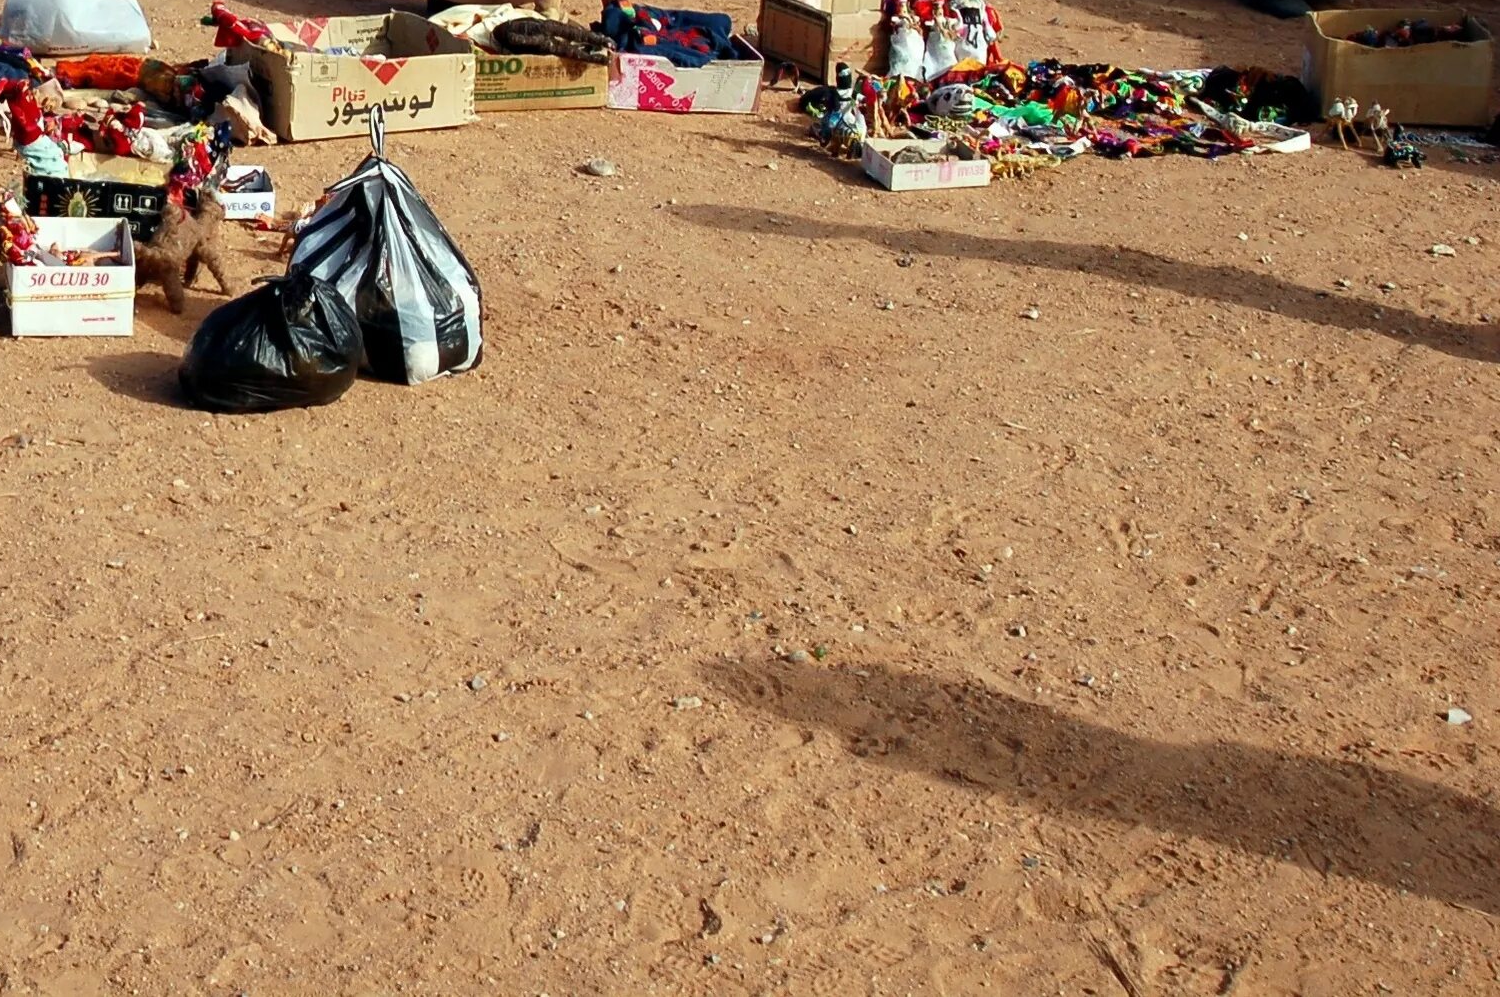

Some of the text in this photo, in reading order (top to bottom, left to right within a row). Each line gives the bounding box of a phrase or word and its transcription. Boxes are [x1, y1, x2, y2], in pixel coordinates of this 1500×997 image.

[476, 57, 523, 75] IDO
[332, 86, 366, 102] Plus
[29, 271, 110, 288] 50 CLUB 30
